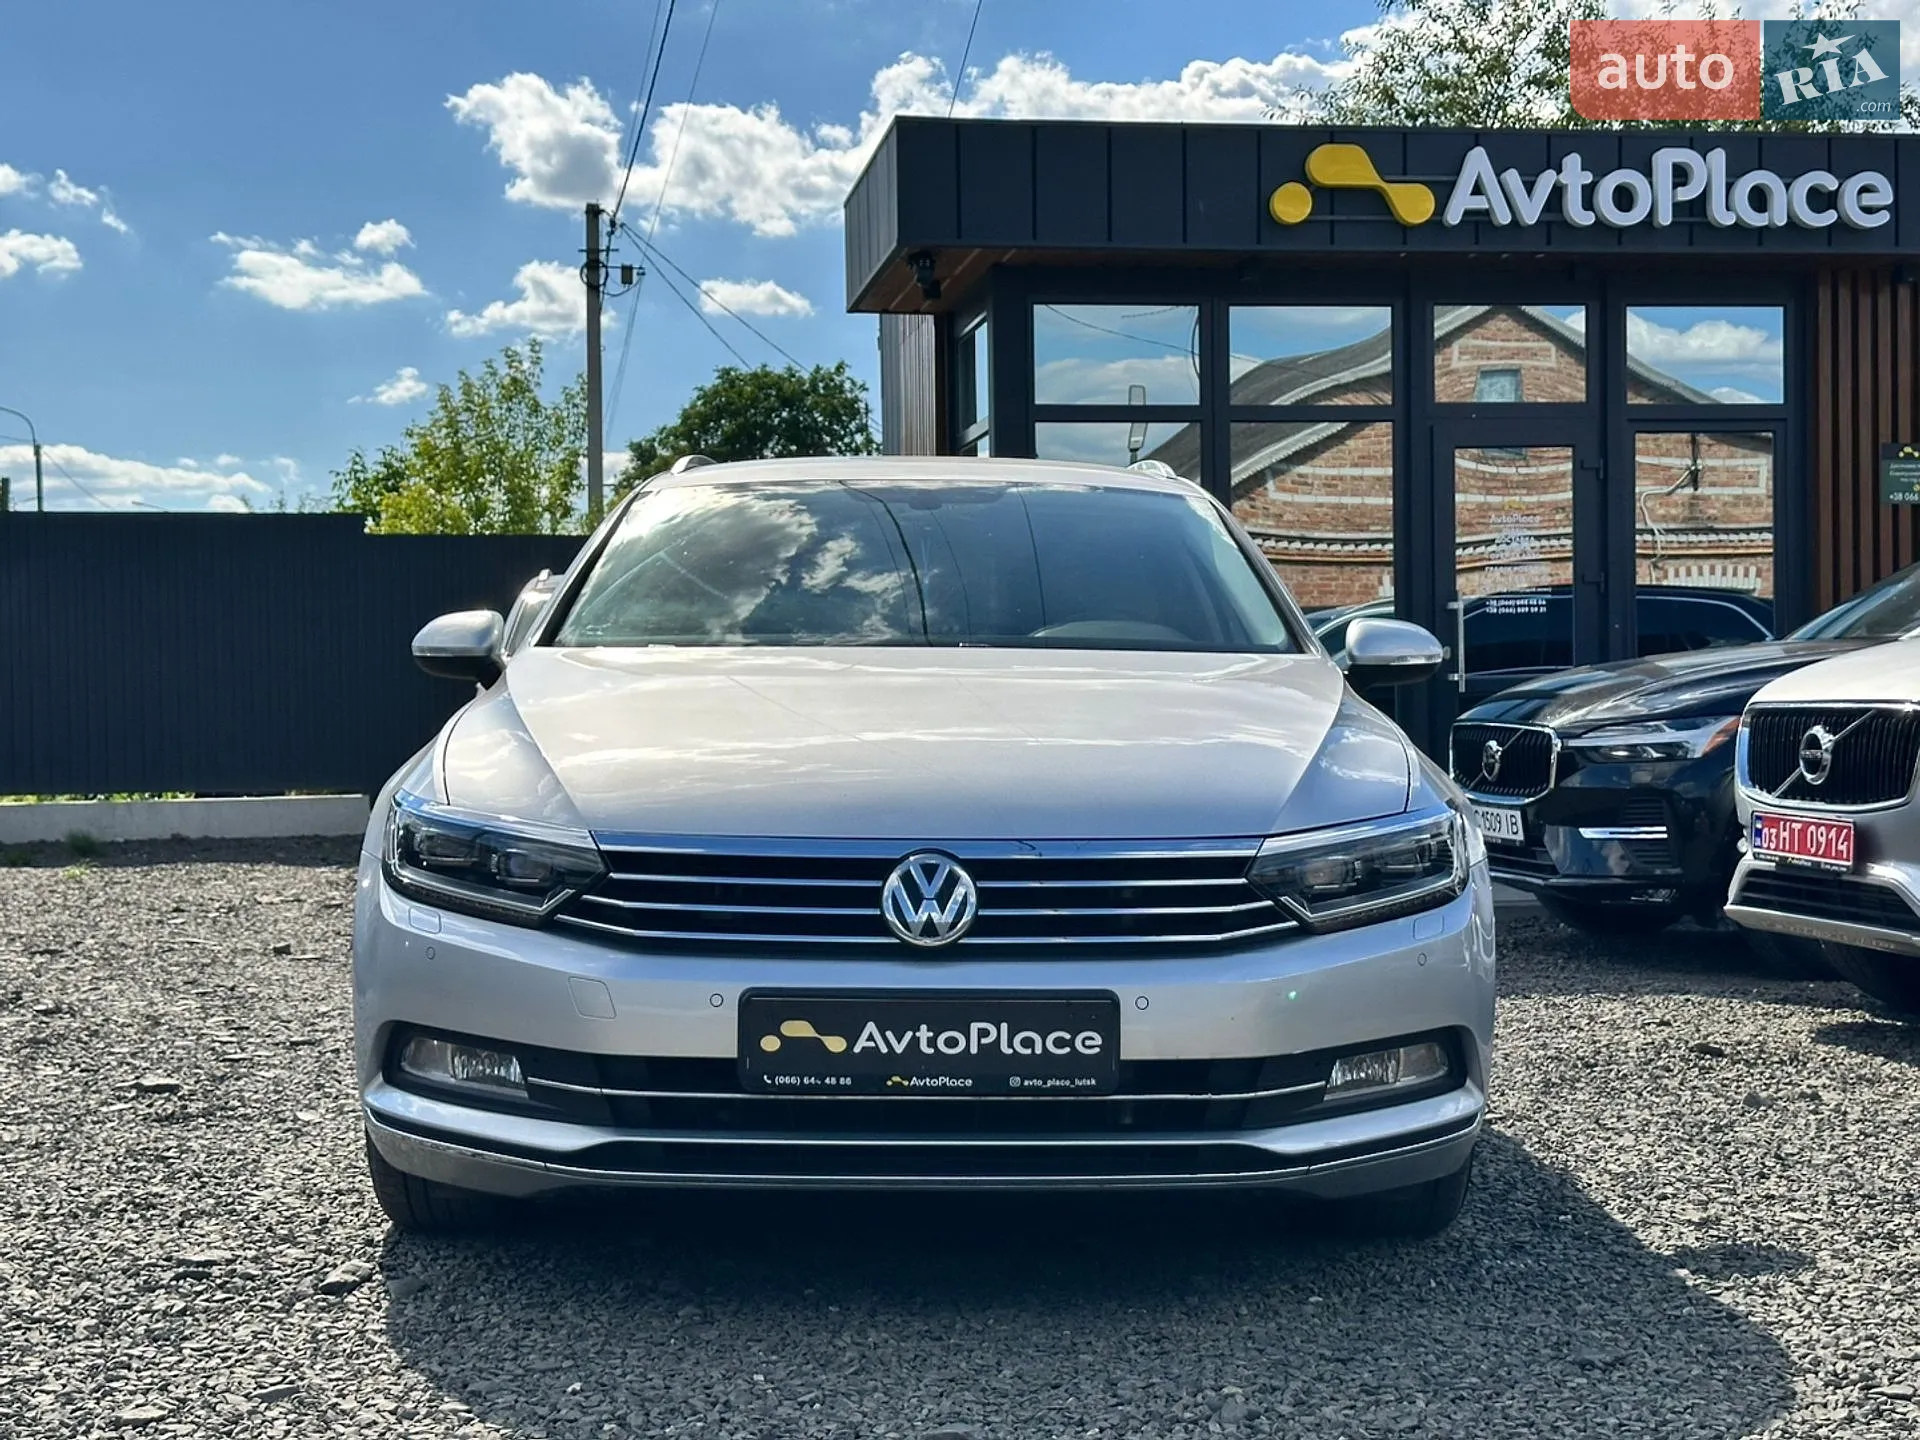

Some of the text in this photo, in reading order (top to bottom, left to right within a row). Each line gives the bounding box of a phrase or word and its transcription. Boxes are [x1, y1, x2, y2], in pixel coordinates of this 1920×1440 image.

[1442, 145, 1895, 230] AvtoPlace
[1761, 821, 1849, 859] 03 HT 0914
[852, 1020, 1103, 1055] AvtoPlace
[909, 1076, 973, 1087] AvtoPlace
